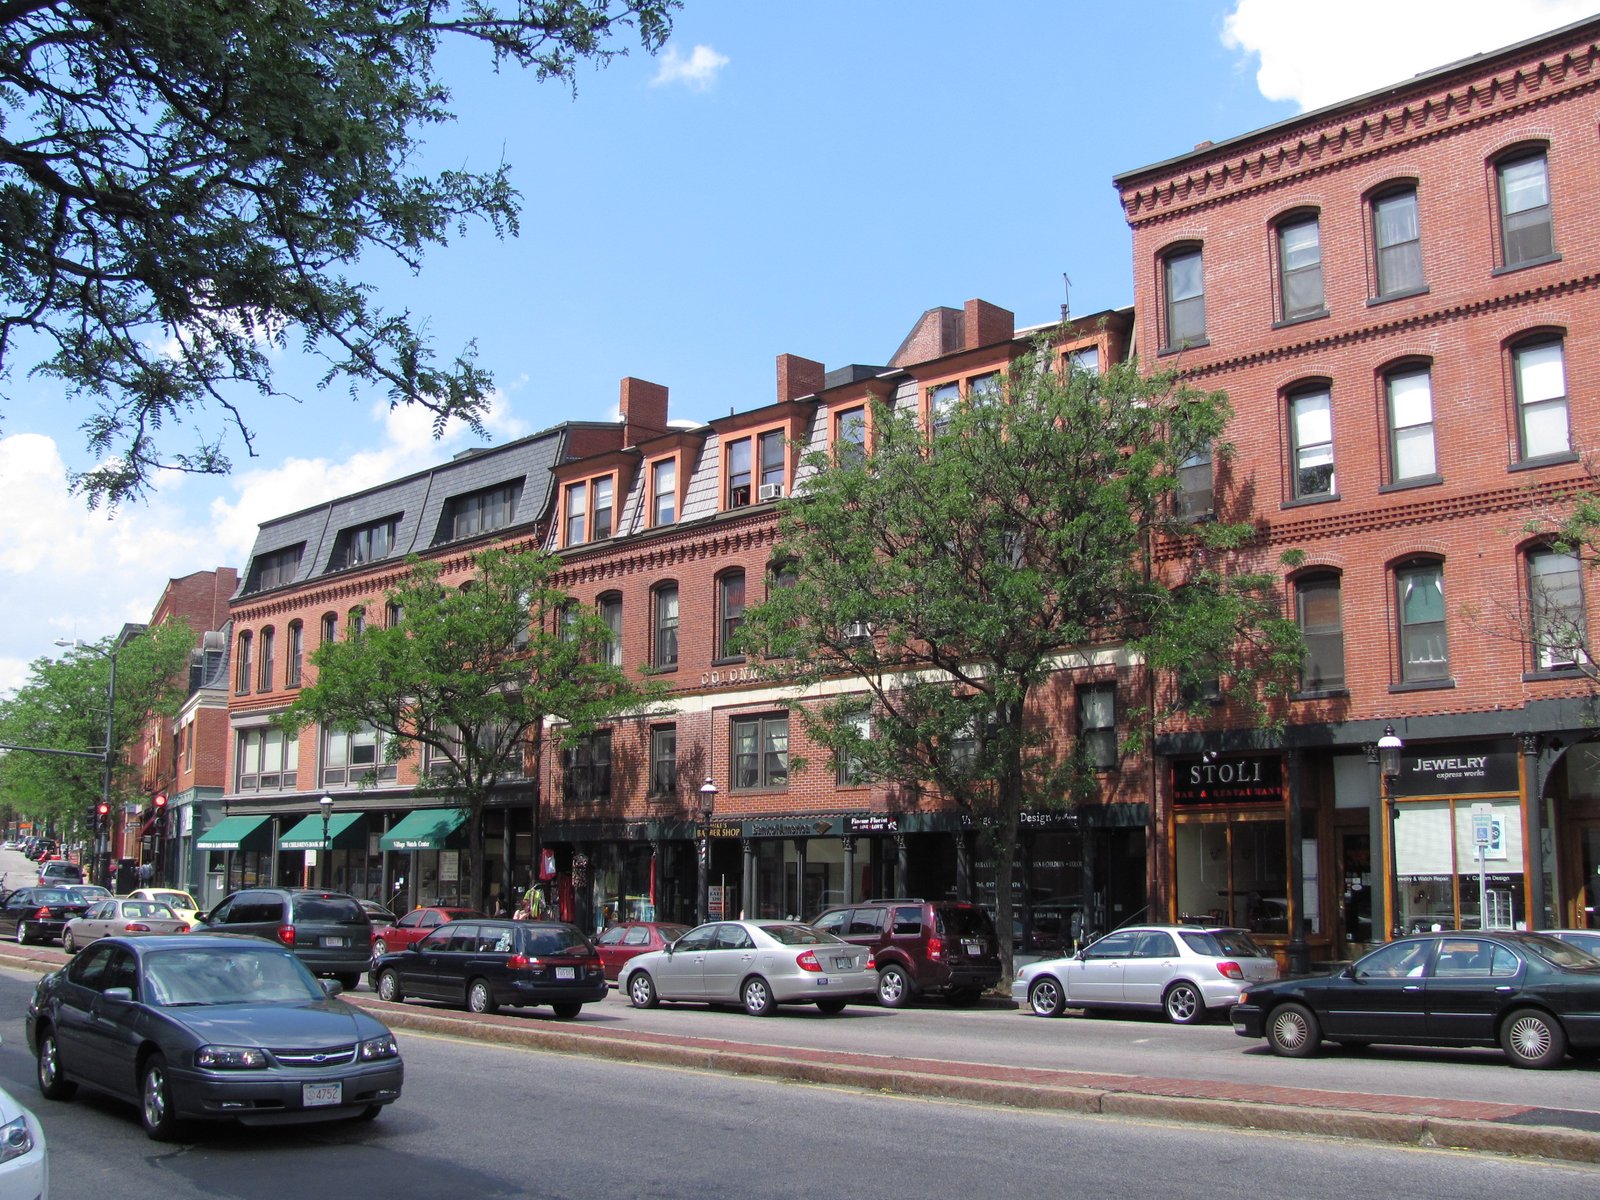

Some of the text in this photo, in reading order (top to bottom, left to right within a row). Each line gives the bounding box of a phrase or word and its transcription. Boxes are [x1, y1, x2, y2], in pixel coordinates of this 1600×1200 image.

[1412, 756, 1487, 772] JEWELRY
[1190, 762, 1261, 785] STOLI
[1436, 769, 1485, 780] express works
[1174, 786, 1281, 799] BAR & RESTAURANT
[1020, 811, 1052, 826] Design
[696, 828, 740, 838] BABER SHOP
[316, 1088, 338, 1099] 4752
